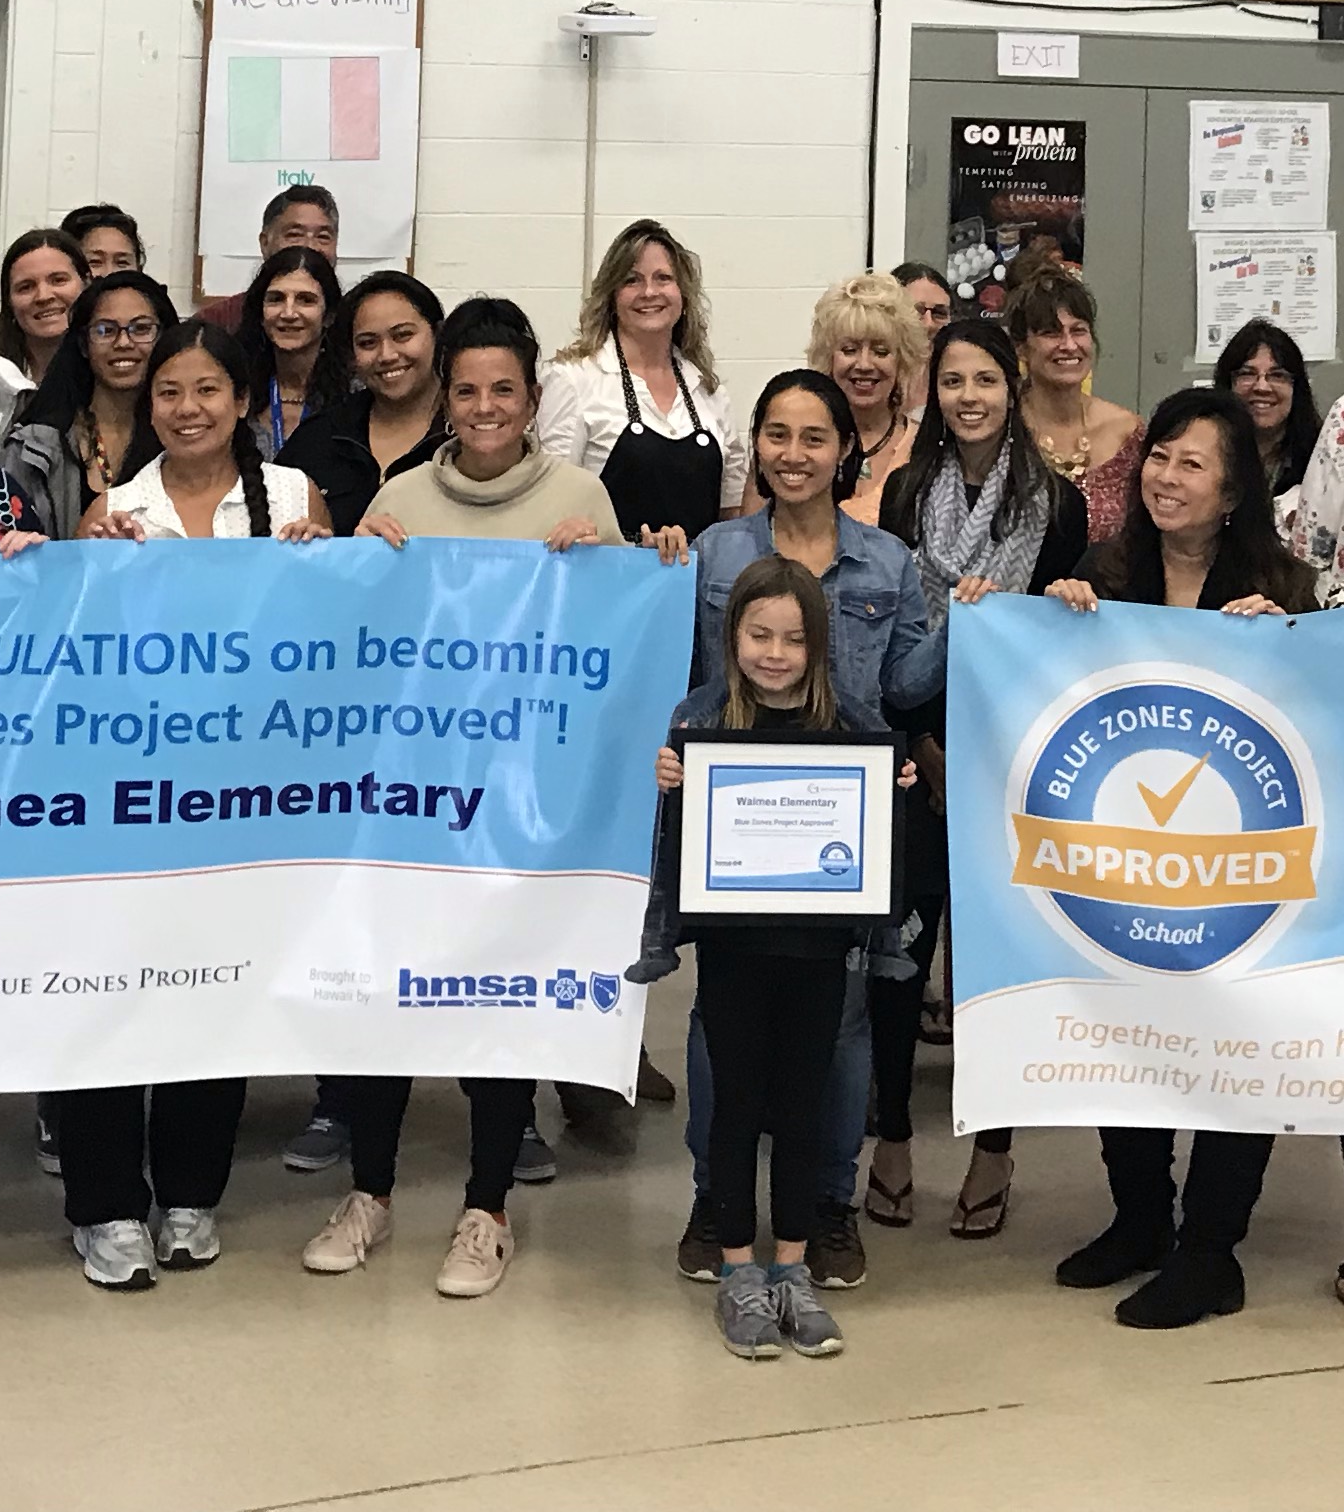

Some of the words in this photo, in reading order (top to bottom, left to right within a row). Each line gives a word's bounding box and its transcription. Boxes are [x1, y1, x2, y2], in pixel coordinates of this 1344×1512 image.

[1012, 45, 1065, 68] EXIT
[964, 125, 1000, 145] GO
[1008, 126, 1065, 146] LEAN
[1012, 142, 1077, 166] protein
[278, 169, 315, 186] Italy
[959, 167, 1014, 177] TEMPTING
[981, 180, 1047, 190] SATISFYING
[270, 639, 337, 673] on
[357, 626, 611, 691] becoming
[55, 699, 243, 756] Project
[1047, 731, 1101, 800] BLUE
[1098, 705, 1194, 742] ZONES
[1201, 716, 1287, 810] PROJECT
[114, 770, 484, 831] Elementary
[736, 797, 777, 806] Waimea
[780, 797, 837, 809] Elementary
[1129, 918, 1205, 945] School
[42, 969, 128, 996] ZONES
[309, 968, 356, 985] Brought
[359, 972, 371, 984] to
[398, 968, 537, 998] hmsa
[356, 990, 371, 1005] by
[1056, 1015, 1199, 1058] Together,
[1213, 1038, 1259, 1060] we
[1271, 1035, 1323, 1060] can
[1023, 1060, 1200, 1096] community
[1211, 1070, 1264, 1098] live
